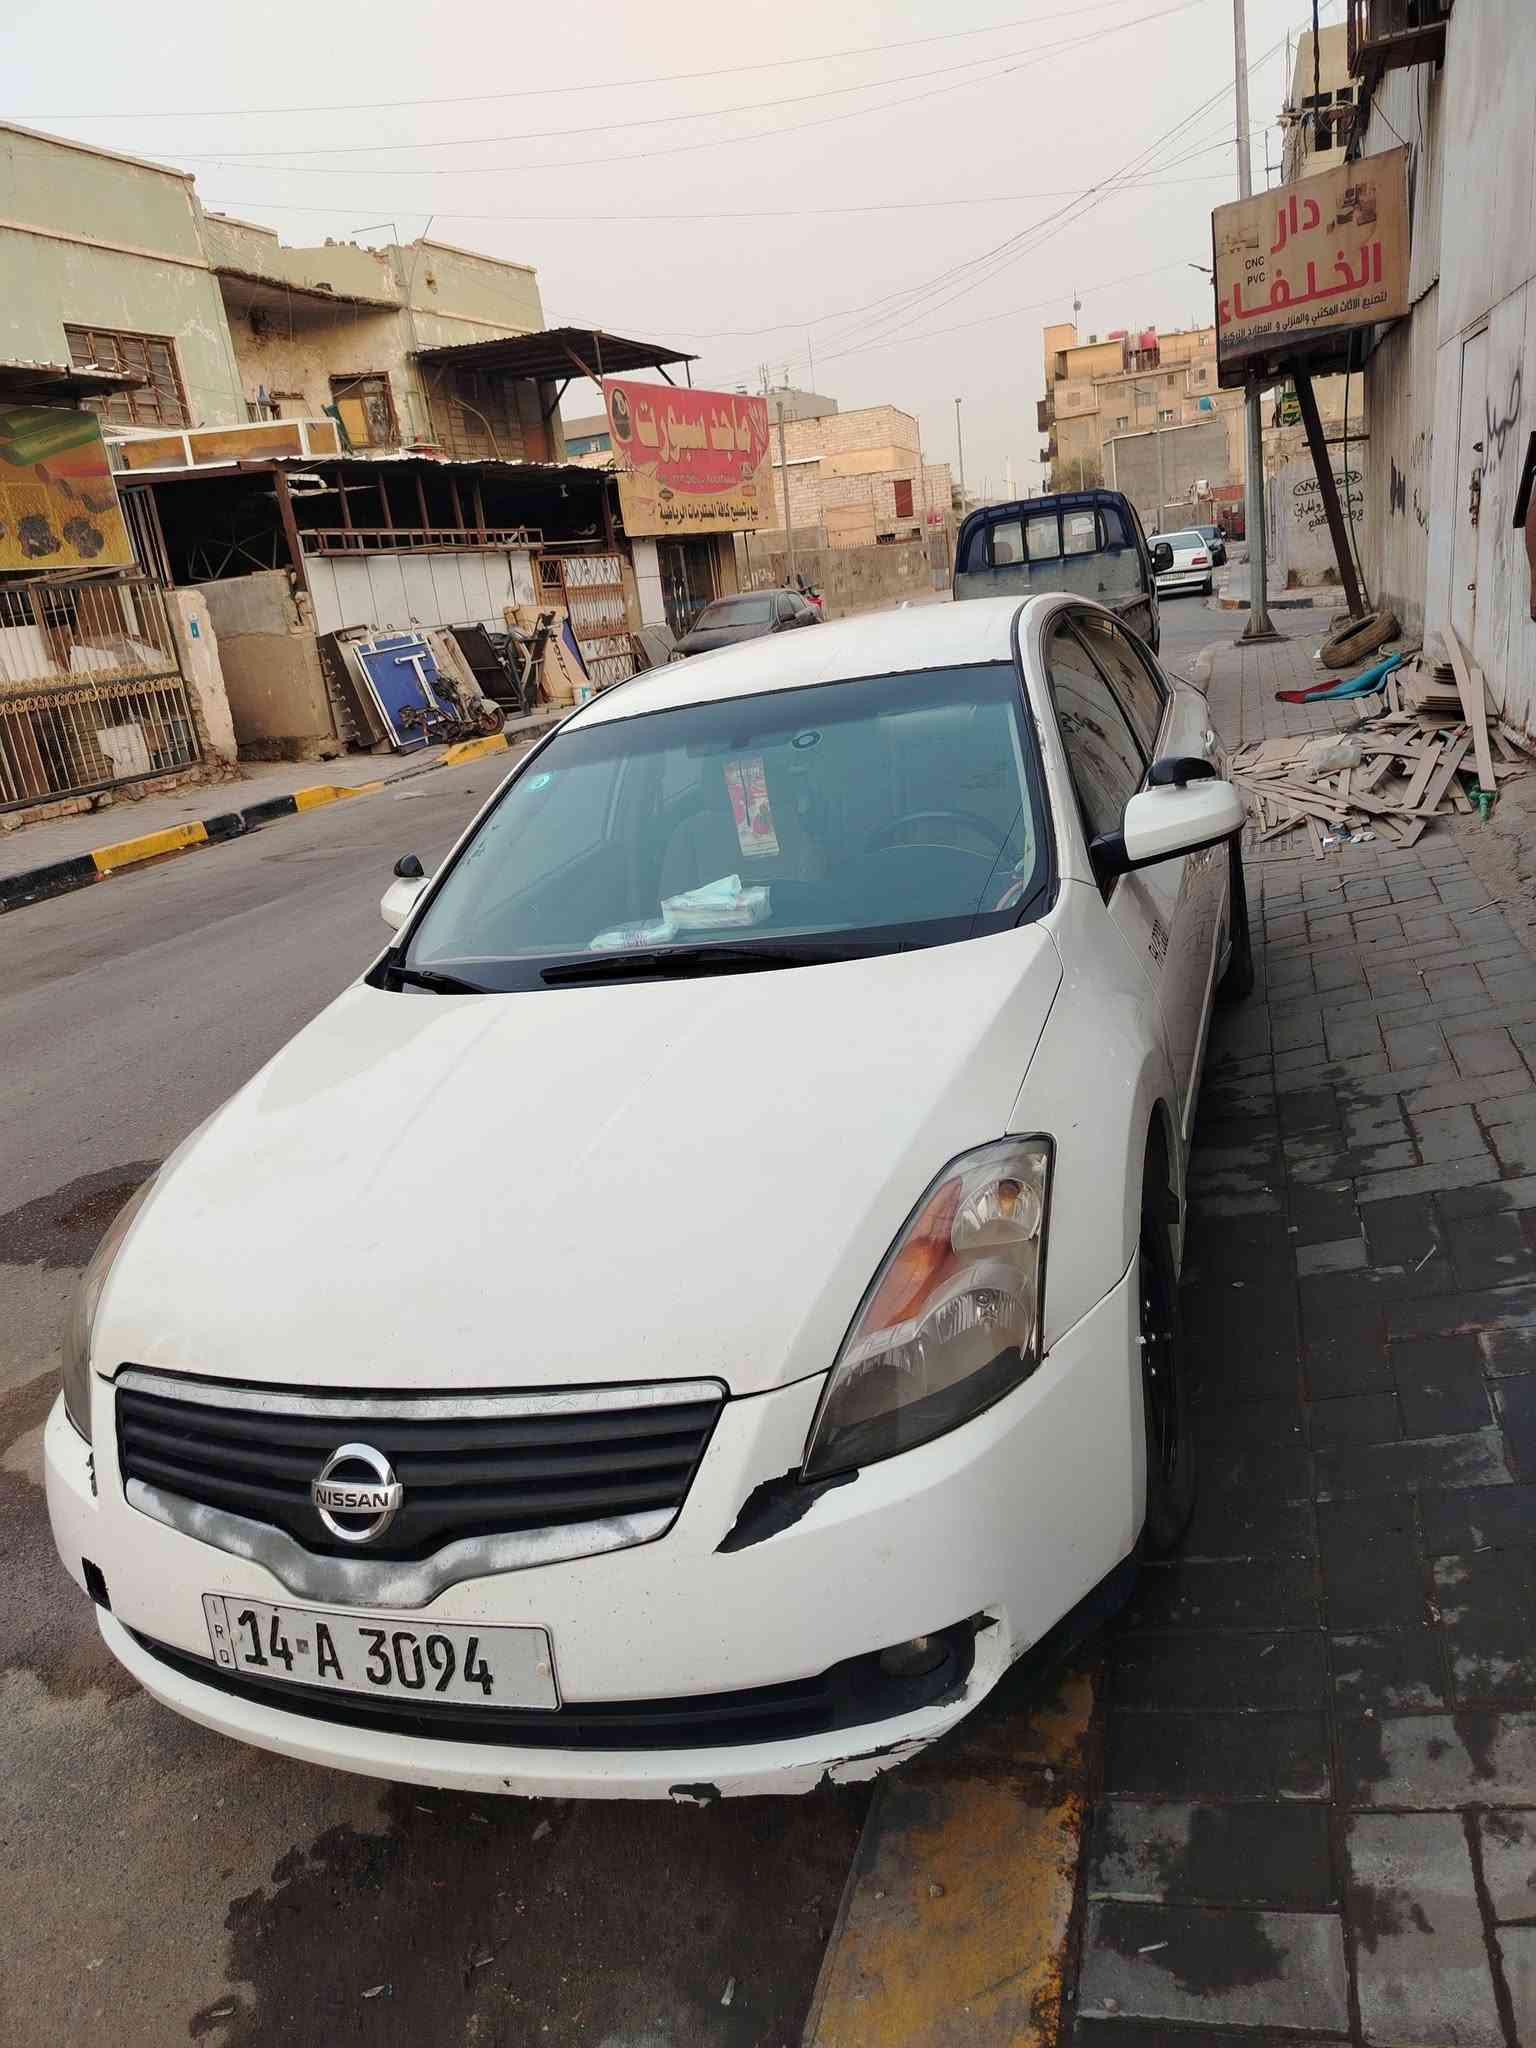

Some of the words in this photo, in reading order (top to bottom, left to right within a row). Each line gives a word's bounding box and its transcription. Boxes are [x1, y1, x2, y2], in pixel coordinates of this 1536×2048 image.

[1270, 195, 1321, 254] دار
[1219, 240, 1382, 326] الخلفاء
[1245, 256, 1265, 270] CNC
[1247, 271, 1266, 286] PVC
[635, 400, 708, 464] سبورت
[710, 398, 752, 463] ماجد
[315, 1486, 389, 1508] NISSAN
[237, 1609, 293, 1671] 14
[315, 1622, 344, 1681] A
[359, 1627, 494, 1695] 3094
